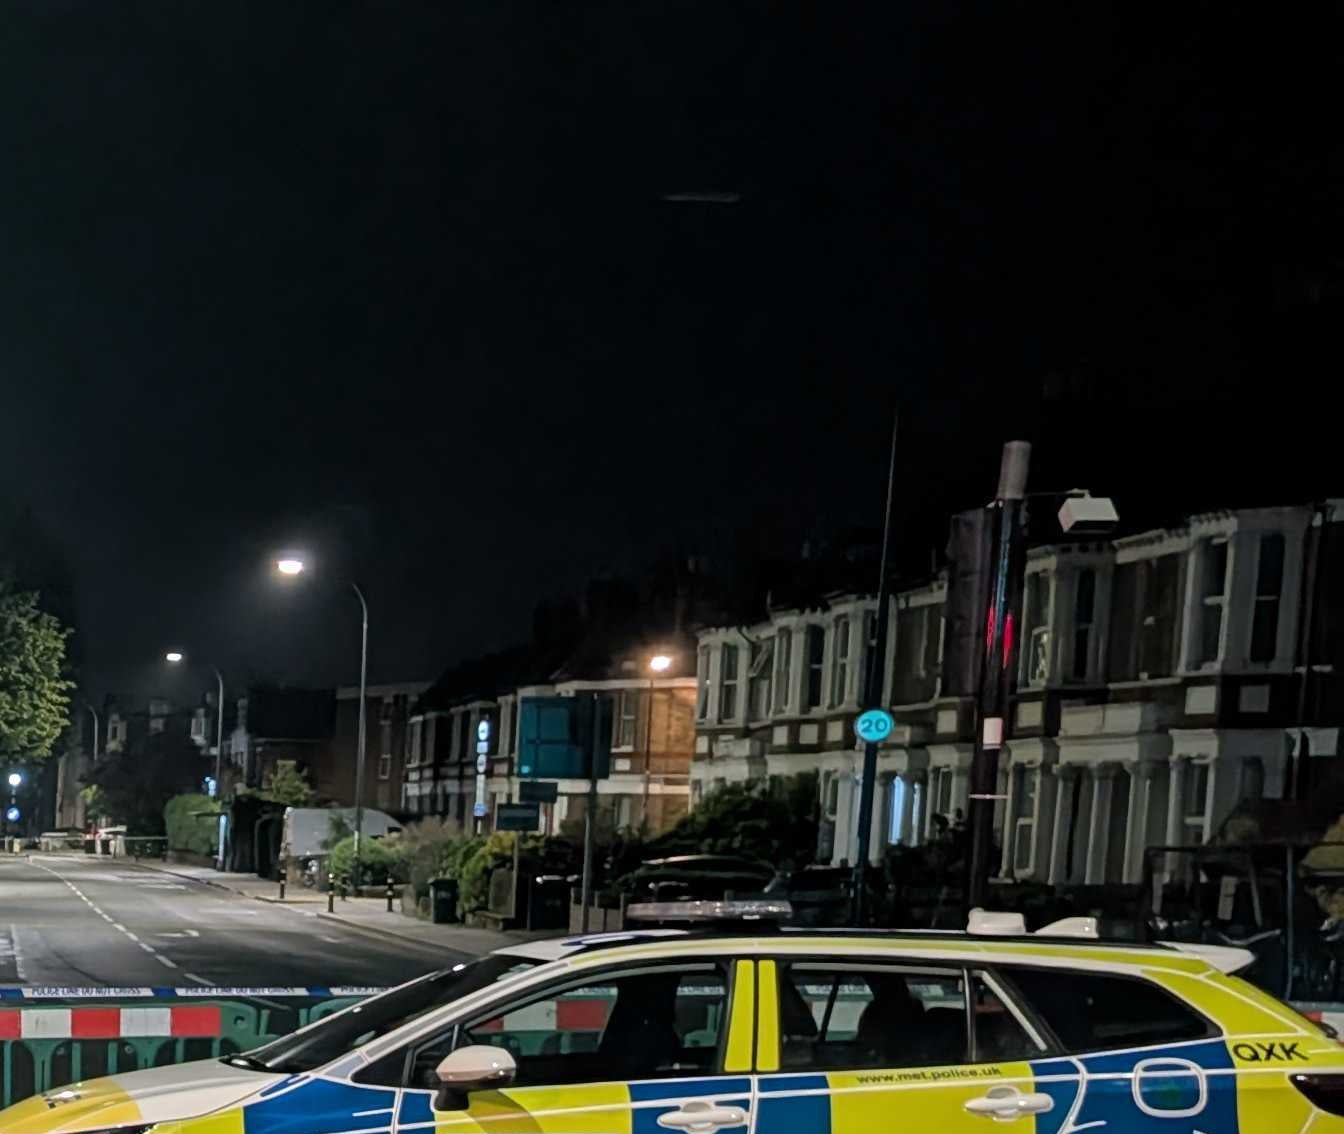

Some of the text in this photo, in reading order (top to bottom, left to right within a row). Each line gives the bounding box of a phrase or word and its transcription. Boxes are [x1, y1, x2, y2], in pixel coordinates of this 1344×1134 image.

[861, 717, 888, 733] 20
[1233, 1041, 1309, 1063] QXK
[857, 1066, 1002, 1084] www.met.police.uk
